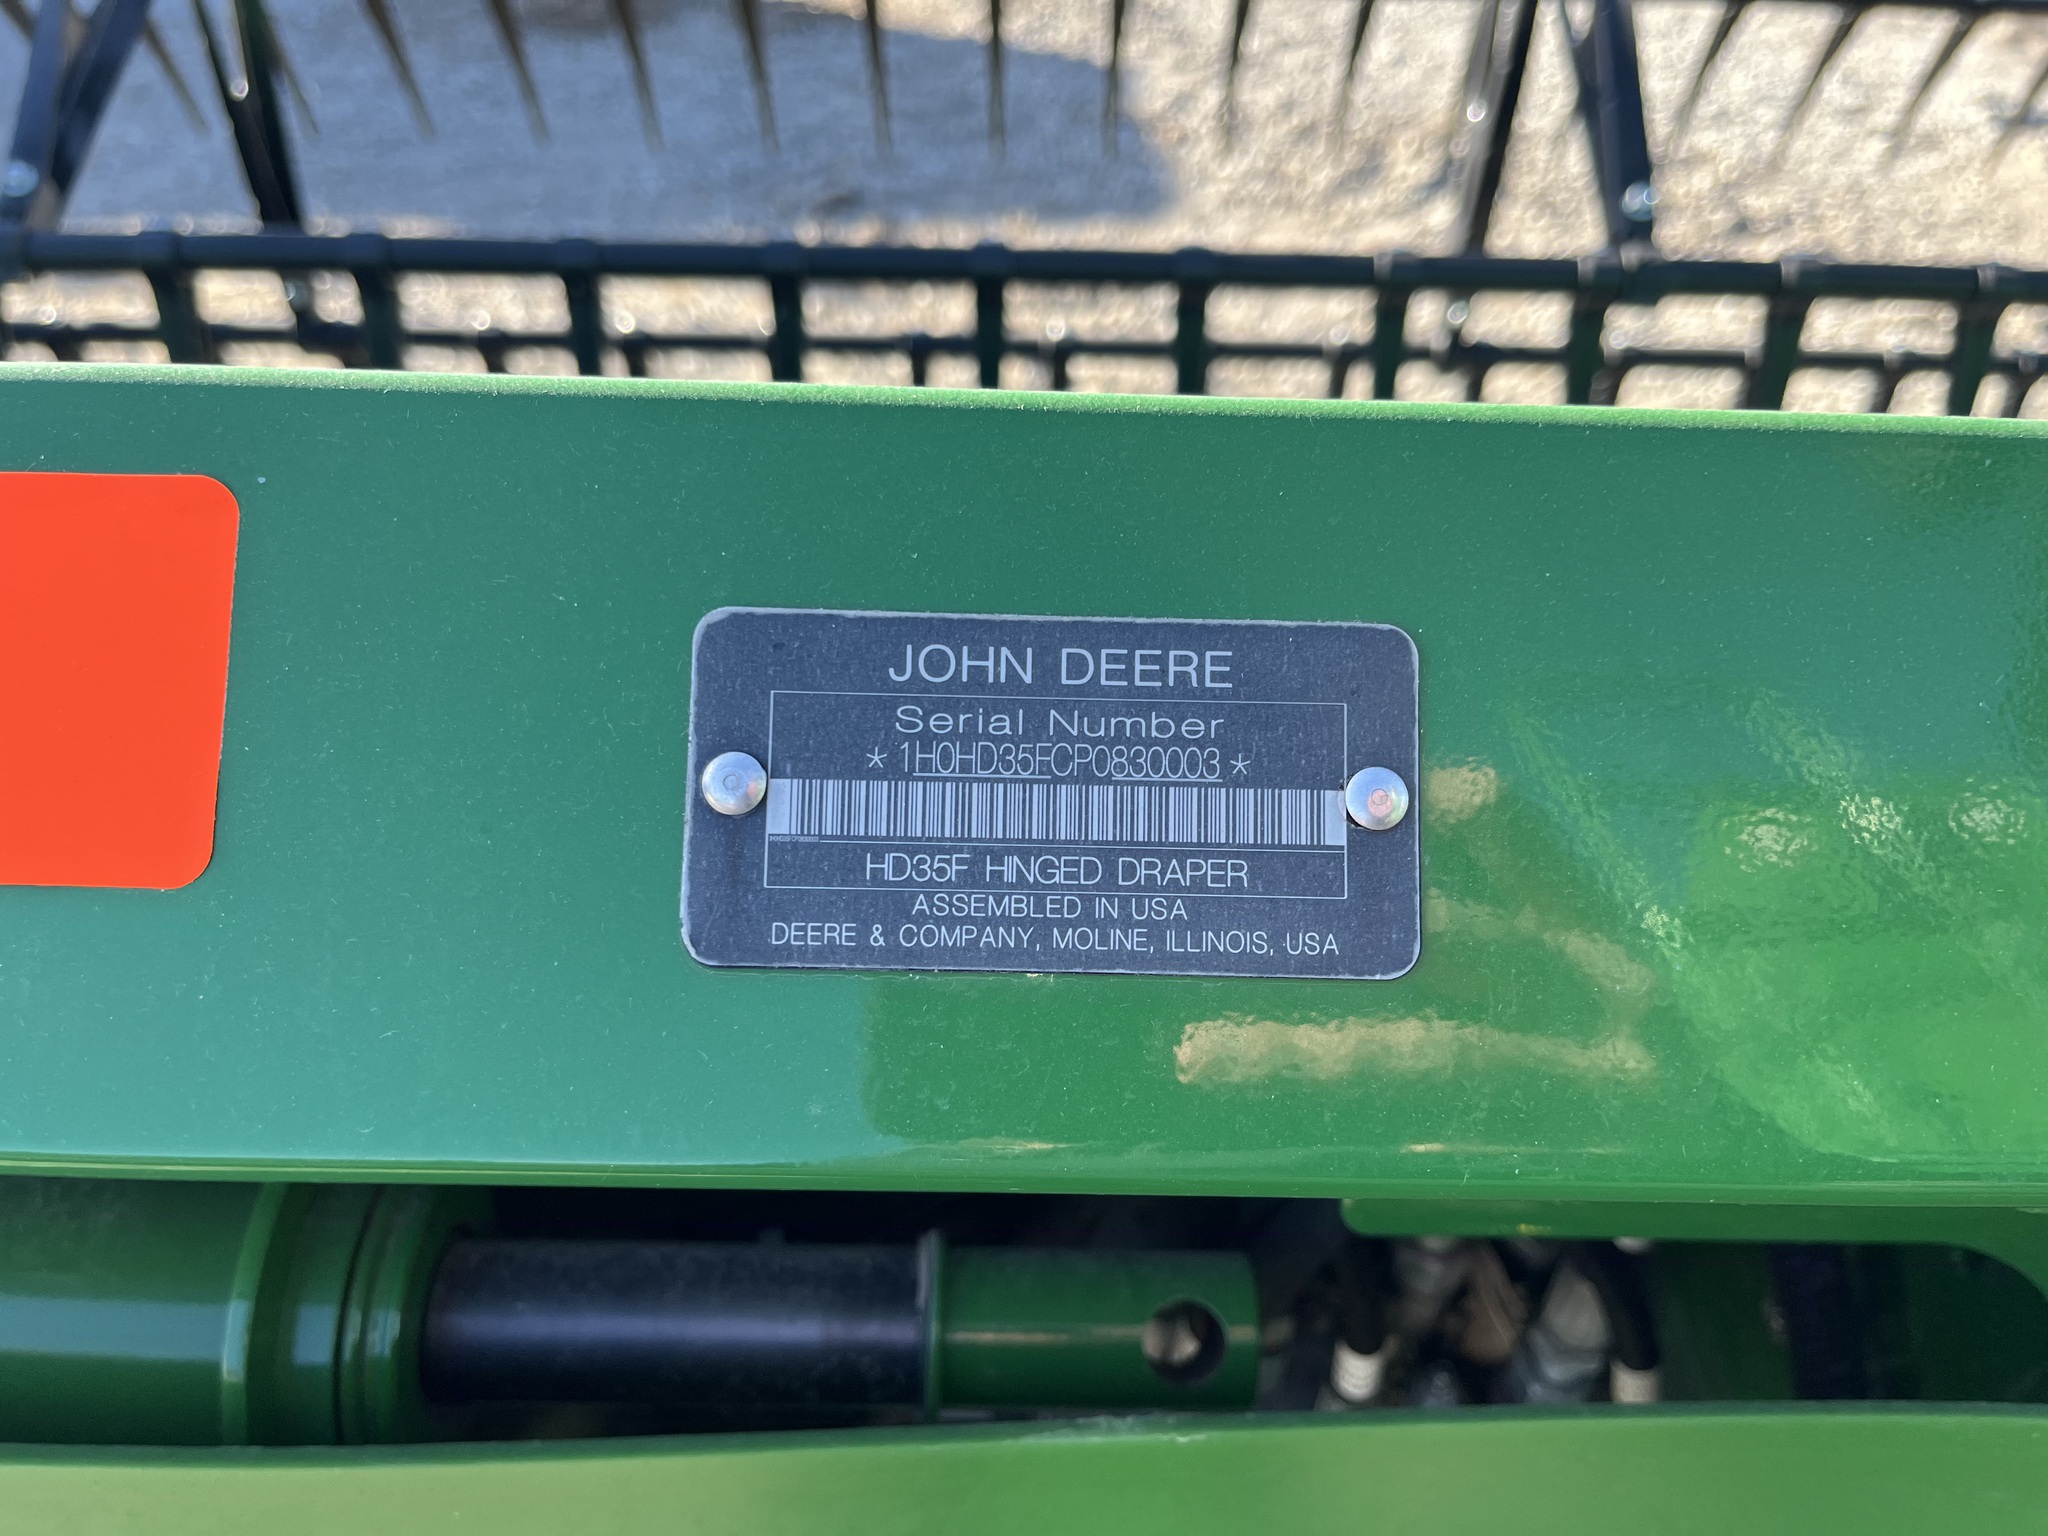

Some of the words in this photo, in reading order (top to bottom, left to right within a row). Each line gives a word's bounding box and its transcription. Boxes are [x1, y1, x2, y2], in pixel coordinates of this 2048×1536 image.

[889, 644, 1032, 684] JOHN
[1060, 648, 1233, 690] DEERE
[896, 705, 1024, 735] Serial
[1050, 709, 1224, 738] Number
[899, 740, 1223, 781] 1H0HD35FCP0830003
[866, 853, 970, 883] HD35F
[985, 855, 1103, 885] HINGED
[1118, 858, 1249, 888] DRAPER
[912, 893, 1082, 919] ASSEMBLED
[1095, 897, 1119, 920] IN
[1132, 898, 1188, 921] USA
[771, 922, 857, 947] DEERE
[869, 924, 886, 947] &
[899, 924, 1040, 952] COMPANY,
[1053, 927, 1154, 954] MOLINE,
[1166, 928, 1274, 957] ILLINOIS,
[1287, 930, 1340, 957] USA
